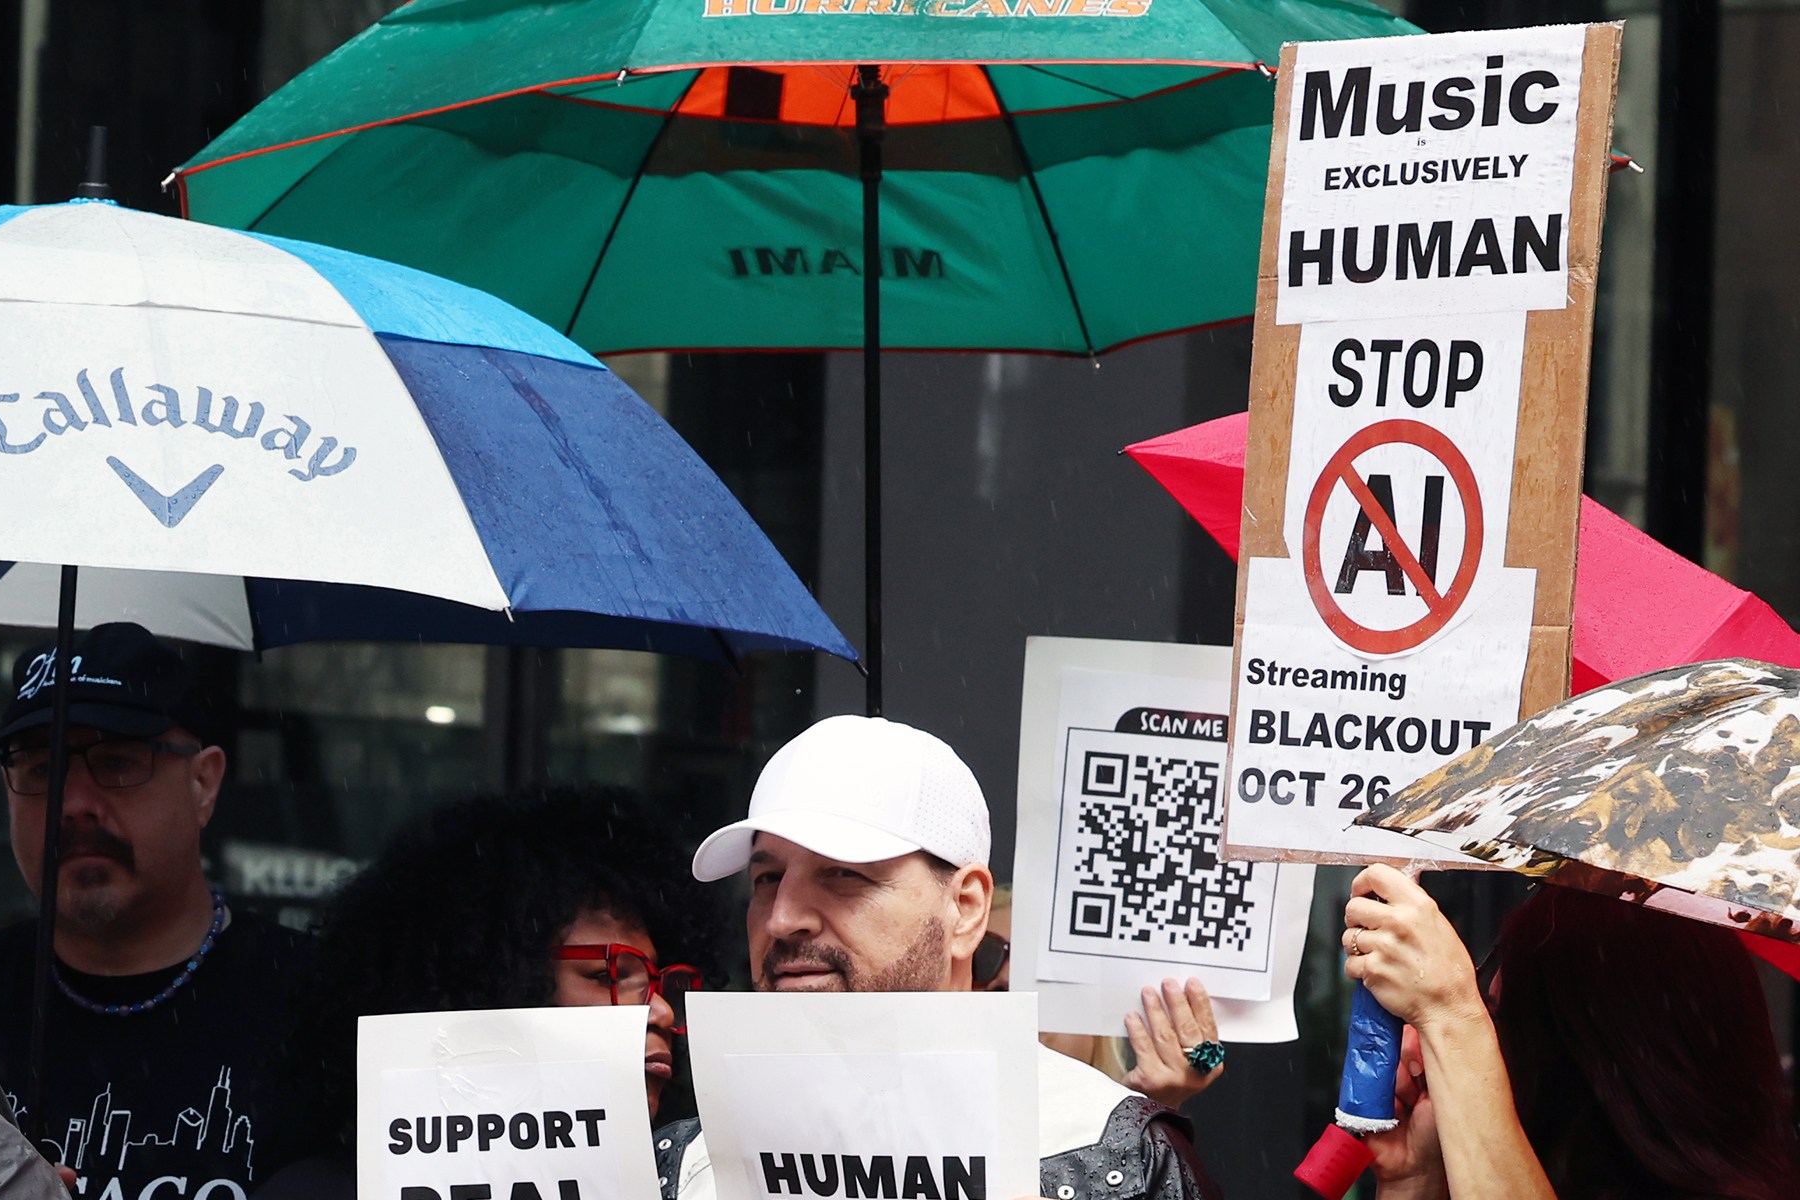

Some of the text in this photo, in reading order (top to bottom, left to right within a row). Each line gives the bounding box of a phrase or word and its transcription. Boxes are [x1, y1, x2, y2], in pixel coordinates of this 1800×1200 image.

[1300, 55, 1560, 142] Music
[1417, 138, 1426, 146] is
[1324, 153, 1528, 191] EXCLUSIVELY
[1288, 213, 1563, 288] HUMAN
[1328, 338, 1484, 408] STOP
[1334, 474, 1445, 596] AI
[1246, 658, 1407, 701] Streaming
[1140, 711, 1224, 738] SCAN ME
[1248, 709, 1492, 756] BLACKOUT
[1238, 768, 1392, 813] OCT 26
[388, 1107, 606, 1156] SUPPORT
[759, 1152, 987, 1200] HUMAN
